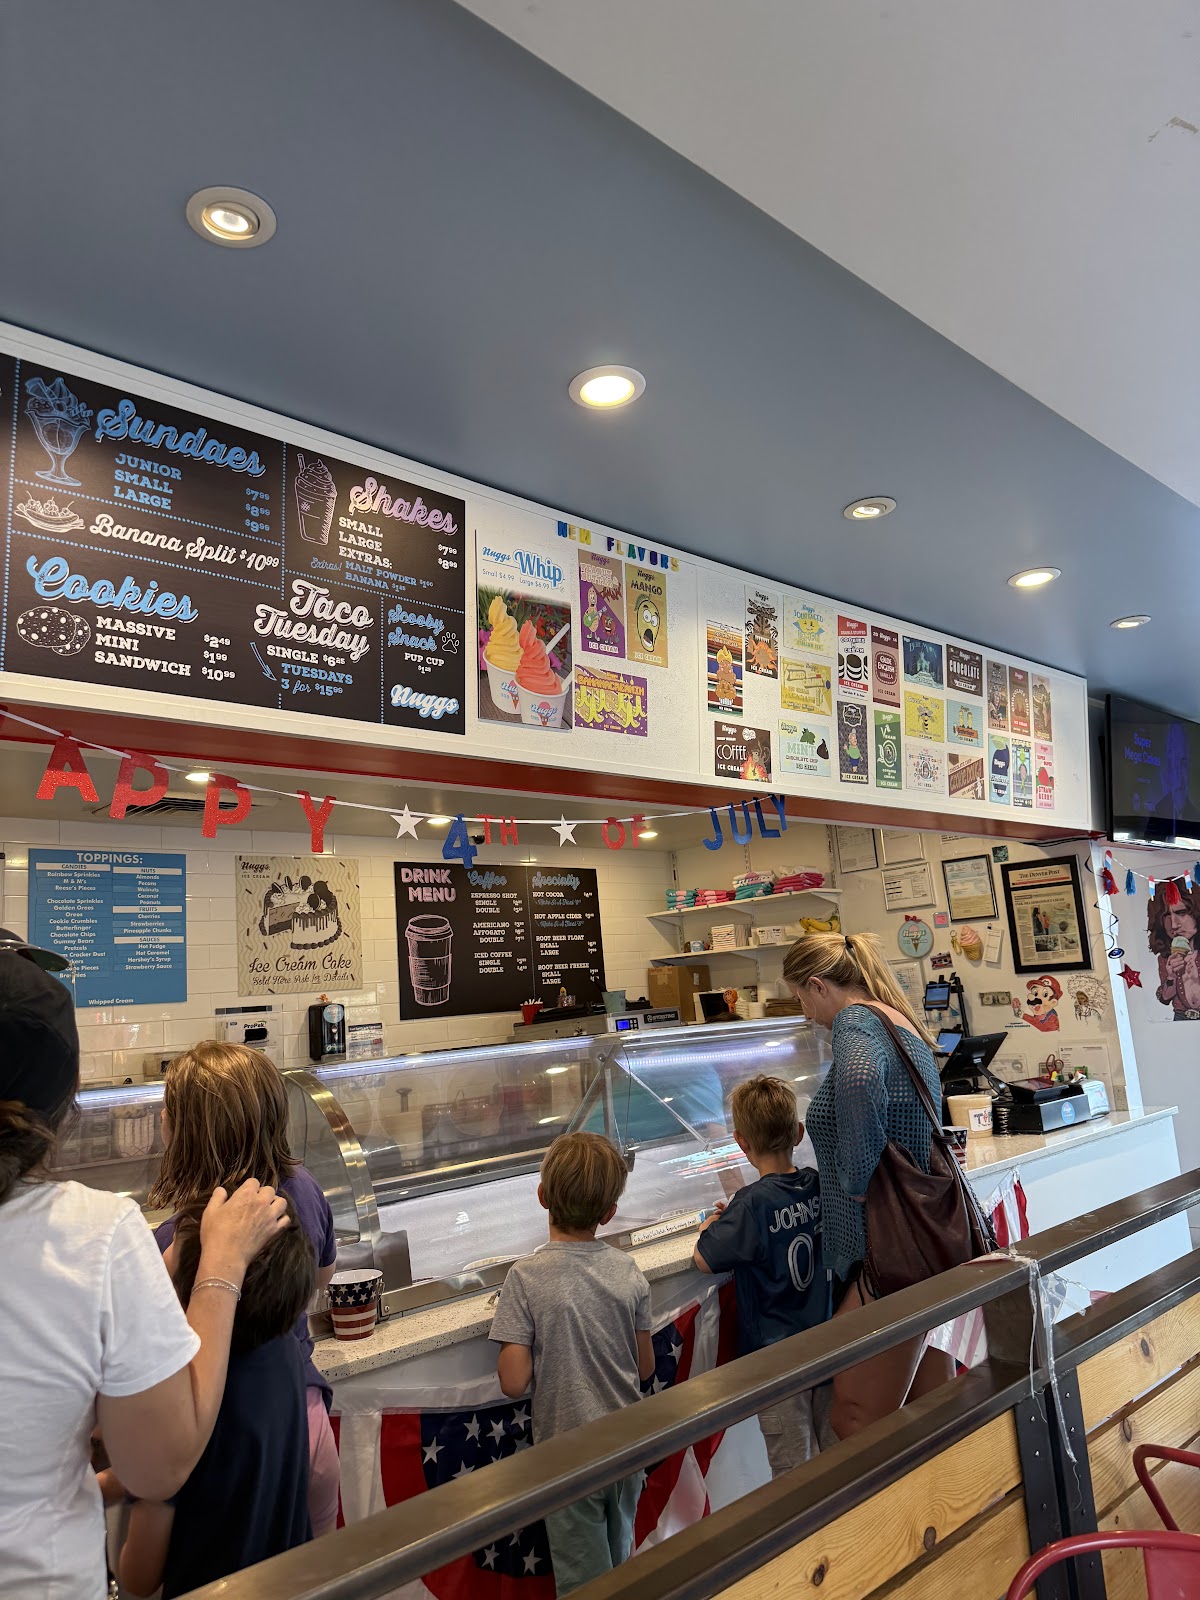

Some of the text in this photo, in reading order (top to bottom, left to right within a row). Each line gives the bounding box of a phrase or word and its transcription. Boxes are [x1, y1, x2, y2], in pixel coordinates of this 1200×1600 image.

[95, 399, 265, 478] Sundaes
[115, 453, 181, 480] JUNIOR
[115, 469, 173, 494] SMALL
[114, 485, 171, 510] LARGE
[349, 476, 458, 535] Shakes
[339, 517, 384, 537] SMALL
[89, 513, 183, 552] Banana
[186, 537, 238, 565] Split
[339, 531, 382, 552] LARGE
[558, 520, 680, 572] NEW FLAVORS
[339, 546, 392, 569] EXTRAS:
[483, 546, 563, 588] Nuggs Whip
[311, 556, 416, 586] Extras! MALT POWDER
[345, 572, 389, 590] BANANA
[483, 569, 498, 577] Small
[520, 578, 533, 586] Large
[26, 554, 198, 622] Cookies
[631, 580, 662, 596] MANGO
[290, 579, 374, 628] Taco
[96, 616, 176, 640] MASSIVE
[388, 604, 445, 636] Scooby
[95, 634, 139, 651] MINI
[254, 604, 370, 663] Tuesday
[388, 626, 437, 652] Snack
[95, 651, 191, 676] SANDWICH
[267, 645, 318, 664] SINGLE
[404, 652, 444, 666] PUP CUP
[281, 663, 353, 684] TUESDAYS
[950, 660, 980, 680] CHOCOLATE
[281, 678, 289, 689] 3
[292, 680, 312, 694] for
[391, 684, 459, 720] Nuggs
[787, 742, 816, 757] MINT
[1133, 732, 1151, 749] Super
[600, 814, 645, 850] OF
[703, 794, 788, 850] JULY
[77, 853, 143, 864] TOPPINGS:
[241, 861, 270, 874] Nuggs
[400, 867, 453, 884] DRINK
[467, 870, 507, 890] Coffee
[409, 887, 456, 902] MENU
[249, 952, 352, 973] Ice Cream Cake
[253, 976, 270, 986] Sold
[272, 975, 291, 984] Here
[294, 974, 309, 984] Ask
[324, 973, 349, 982] Details
